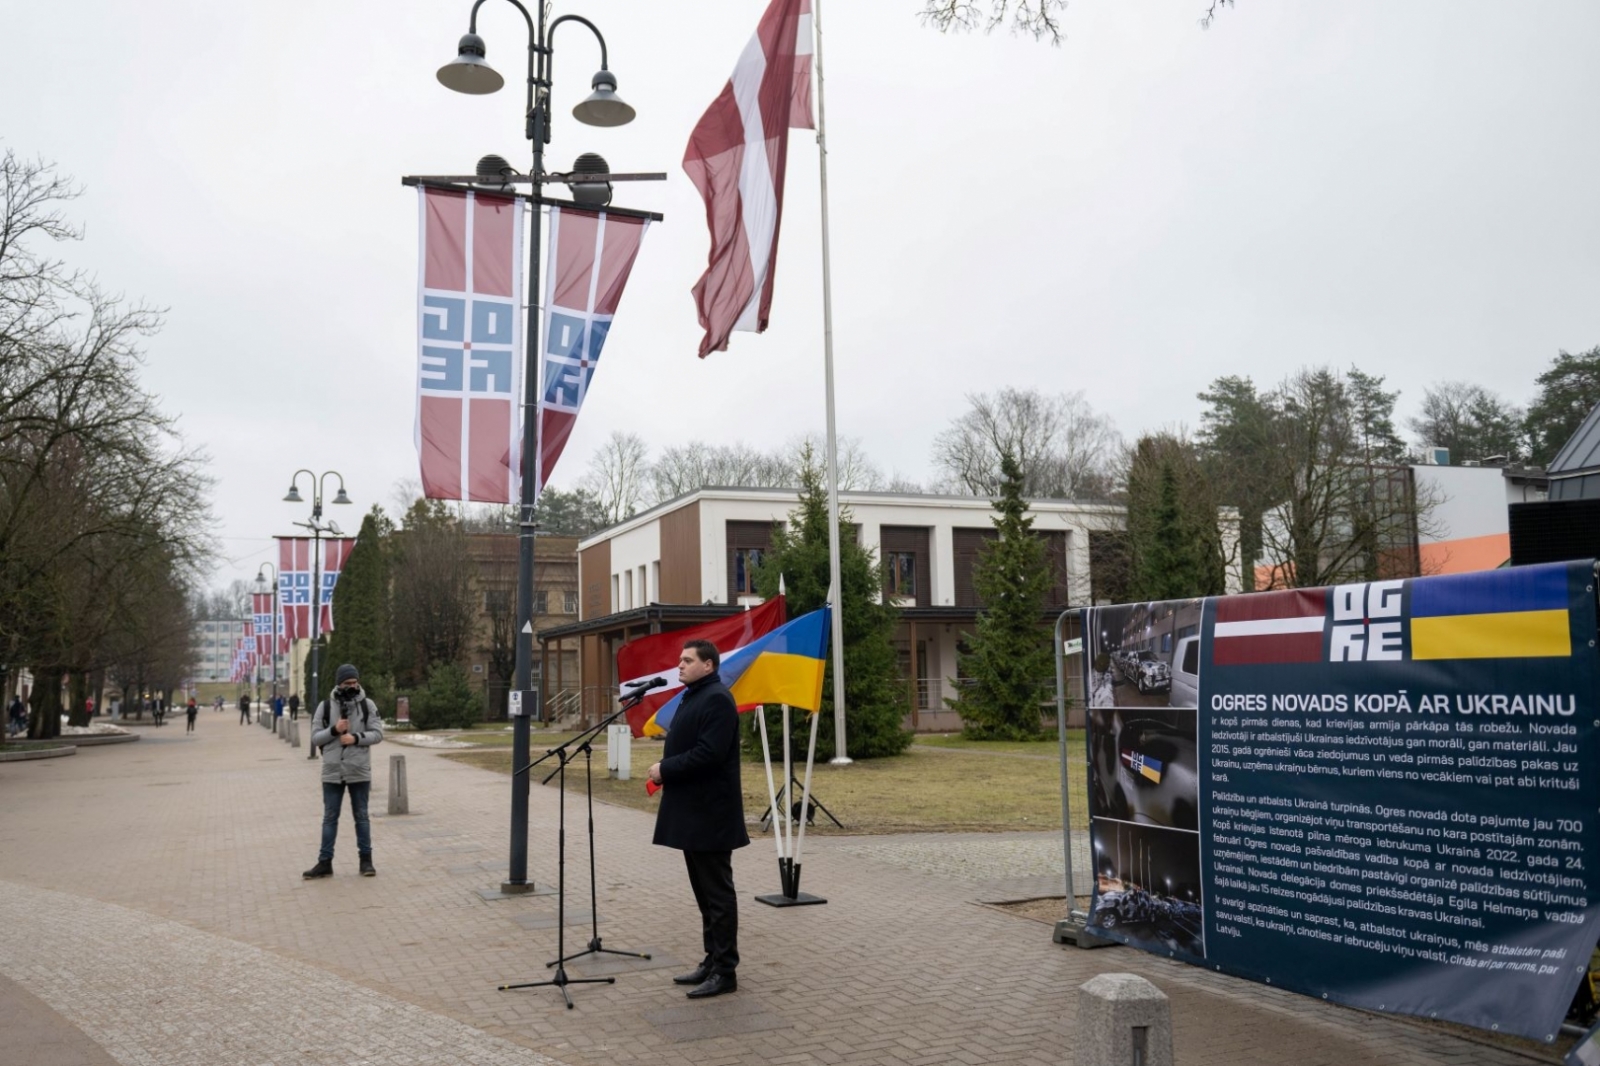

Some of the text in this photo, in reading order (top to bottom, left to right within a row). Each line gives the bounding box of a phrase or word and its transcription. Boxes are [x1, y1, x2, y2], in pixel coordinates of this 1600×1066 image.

[1212, 690, 1576, 715] OGRES NOVADS KOPĀ AR UKRAINU
[1220, 717, 1238, 727] kopš
[1241, 719, 1268, 728] pirmās
[1272, 719, 1301, 728] dienas,
[1306, 719, 1321, 728] kad
[1326, 720, 1364, 730] krievijas
[1370, 721, 1400, 732] armija
[1406, 722, 1449, 732] pārkāpa
[1456, 722, 1473, 732] tās
[1480, 722, 1522, 733] robežu.
[1530, 723, 1577, 735] Novada
[1250, 732, 1256, 740] ir
[1304, 734, 1343, 743] Ukrainas
[1346, 736, 1403, 748] iedzīvotājus
[1406, 739, 1425, 748] gan
[1429, 739, 1465, 750] morāli,
[1468, 741, 1490, 751] gan
[1493, 741, 1549, 752] materiāli.
[1553, 742, 1577, 753] Jau
[1212, 745, 1230, 753] 2015.
[1232, 746, 1251, 756] gadā
[1254, 747, 1291, 757] ogrēnieši
[1294, 749, 1313, 758] vāca
[1317, 750, 1369, 761] ziedojumus
[1389, 753, 1413, 762] veda
[1417, 754, 1454, 765] pirmās
[1458, 757, 1517, 768] palīdzības
[1522, 759, 1558, 771] pakas
[1564, 763, 1578, 771] uz
[1212, 759, 1579, 790] Ukrainu, uzņēma ukraiņu bērnus, kuriem viens no vecākiem vai pat abi krituši
[1212, 806, 1239, 818] ukraiņu
[1275, 813, 1322, 826] organizējot
[1325, 818, 1344, 829] viņu
[1347, 820, 1424, 835] transportēšanu
[1427, 828, 1440, 836] no
[1443, 828, 1467, 839] kara
[1470, 832, 1534, 847] postītajām
[1538, 839, 1584, 851] zonām.
[1259, 795, 1292, 807] atbalsts
[1294, 798, 1328, 810] Ukrainā
[1331, 802, 1372, 814] turpinās.
[1376, 805, 1406, 818] Ogres
[1408, 809, 1447, 820] novadā
[1451, 811, 1476, 823] dota
[1480, 815, 1529, 828] pajumte
[1533, 818, 1552, 831] jau
[1556, 820, 1582, 832] 700
[1212, 819, 1230, 830] Kopš
[1234, 822, 1265, 834] krievijas
[1308, 831, 1330, 841] pilna
[1335, 834, 1371, 846] mēroga
[1377, 838, 1431, 852] iebrukuma
[1437, 844, 1480, 858] Ukrainā
[1486, 849, 1520, 862] 2022.
[1527, 855, 1558, 867] gada
[1566, 857, 1585, 870] 24.
[1244, 838, 1267, 849] Ogres
[1271, 842, 1301, 853] novada
[1306, 846, 1360, 860] pašvaldības
[1365, 853, 1398, 865] vadība
[1404, 856, 1429, 869] kopā
[1435, 862, 1446, 870] ar
[1452, 863, 1493, 877] novada
[1500, 868, 1586, 889] iedzīvotājiem,
[1214, 862, 1245, 875] Ukrainai.
[1248, 868, 1277, 880] Novada
[1281, 871, 1325, 888] delegācija
[1330, 880, 1361, 892] domes
[1367, 886, 1443, 905] priekšsēdētāja
[1449, 896, 1477, 910] Egila
[1483, 901, 1538, 920] Helmaņa
[1260, 854, 1298, 868] iestādēm
[1410, 876, 1457, 889] organizē
[1460, 881, 1520, 898] palīdzības
[1523, 889, 1587, 907] sūtījumus
[1248, 882, 1259, 892] jau
[1260, 884, 1269, 893] 15
[1271, 887, 1294, 898] reizes
[1296, 891, 1344, 906] nogādājusi
[1347, 898, 1396, 914] palīdzības
[1398, 906, 1432, 920] kravas
[1434, 911, 1485, 928] Ukrainai.
[1216, 923, 1242, 937] Latviju.
[1216, 910, 1232, 920] savu
[1256, 917, 1264, 927] ka
[1333, 934, 1342, 942] ar
[1344, 935, 1390, 953] iebrucēju
[1392, 945, 1415, 958] viņu
[1489, 960, 1506, 970] par
[1508, 962, 1537, 972] mums,
[1538, 964, 1559, 974] par
[1291, 911, 1302, 919] un
[1304, 912, 1340, 927] saprast,
[1344, 919, 1357, 930] ka,
[1360, 922, 1407, 938] atbalstot
[1410, 931, 1461, 948] ukraiņus,
[1465, 940, 1488, 952] mēs
[1542, 948, 1567, 959] paši
